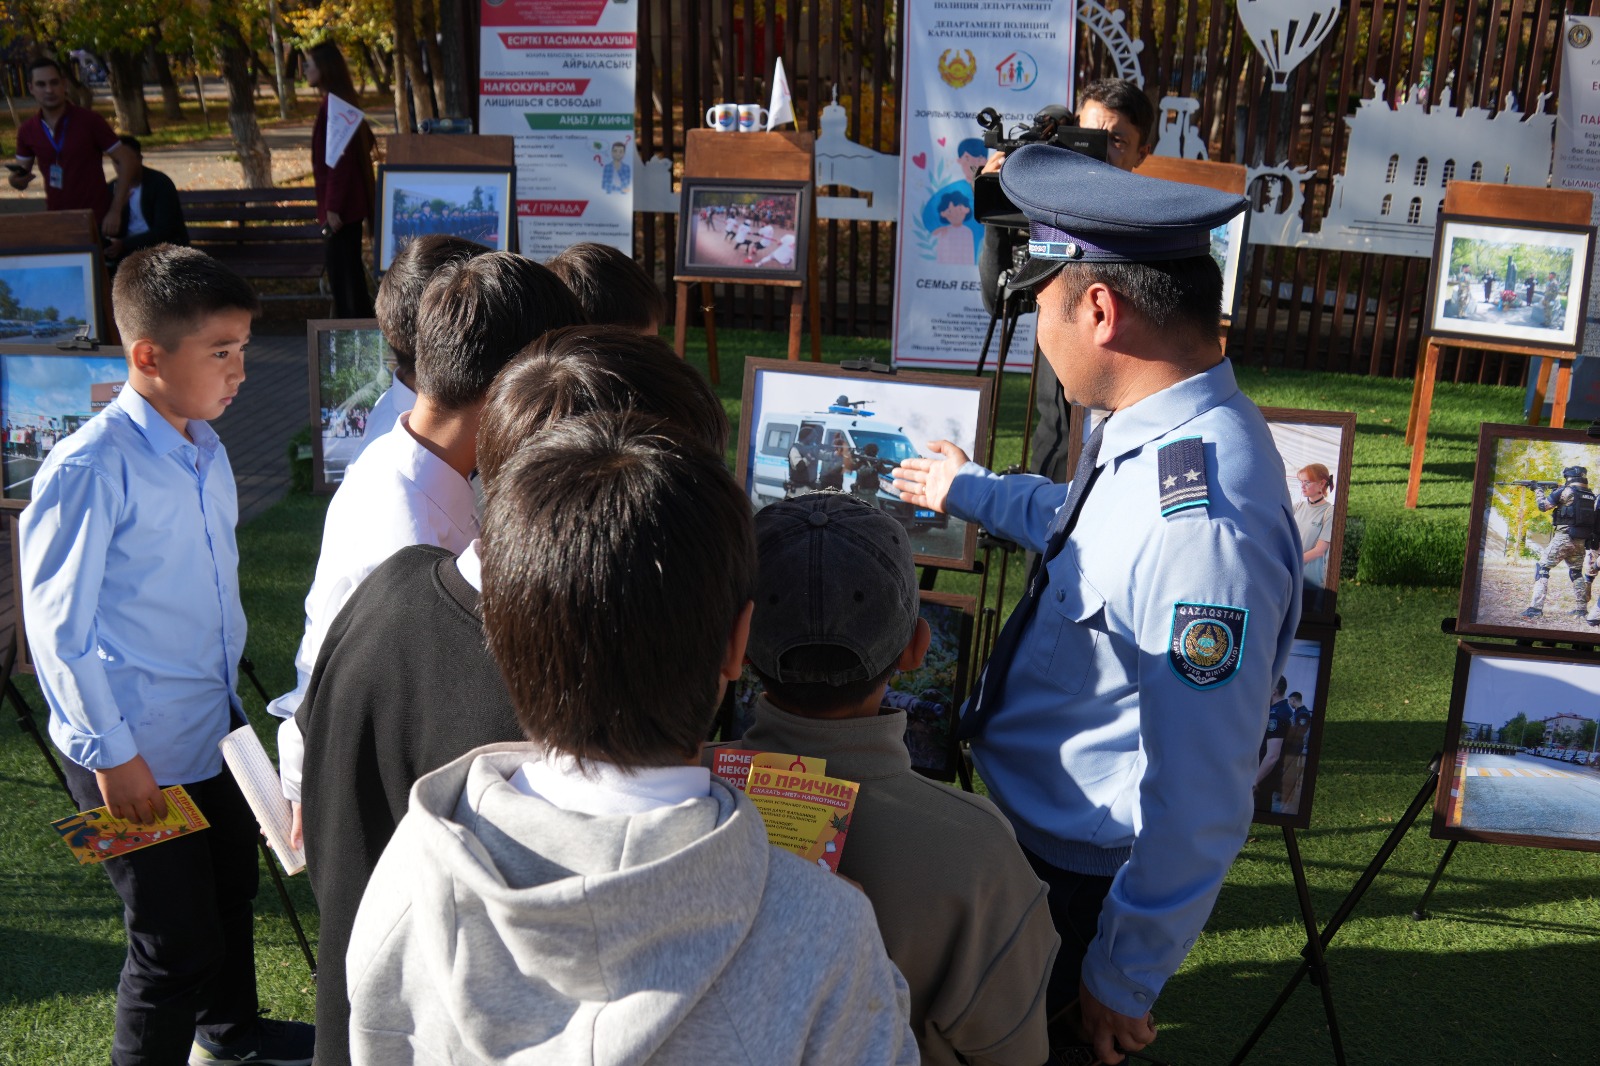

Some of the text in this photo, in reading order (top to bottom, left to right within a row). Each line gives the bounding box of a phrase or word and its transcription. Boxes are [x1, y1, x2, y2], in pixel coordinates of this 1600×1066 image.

[934, 1, 1052, 11] ПОЛИЦИЯ ДЕПАРТАМЕНТІ
[934, 20, 1049, 30] ДЕПАРТАМЕНТ ПОЛИЦИИ
[927, 29, 1056, 39] КАРАГАНДИНСКОЙ ОБЛАСТИ
[507, 35, 634, 46] ЕСІРТКІ ТАСЫМАЛДАУШЫ
[483, 82, 576, 92] НАРКОКУРЬЕРОМ
[484, 98, 602, 108] ЛИШИШЬСЯ СВОБОДЫ!
[597, 115, 631, 125] МИФЫ
[539, 203, 581, 214] ПРАВДА
[916, 278, 958, 290] СЕМЬЯ
[1179, 606, 1243, 621] QAZAQSTAN
[718, 753, 753, 764] ПОЧЕ
[753, 772, 855, 800] 10 ПРИЧИН
[752, 787, 781, 796] СКАЗАТЬ
[801, 793, 847, 808] НАРКОТИКАМ
